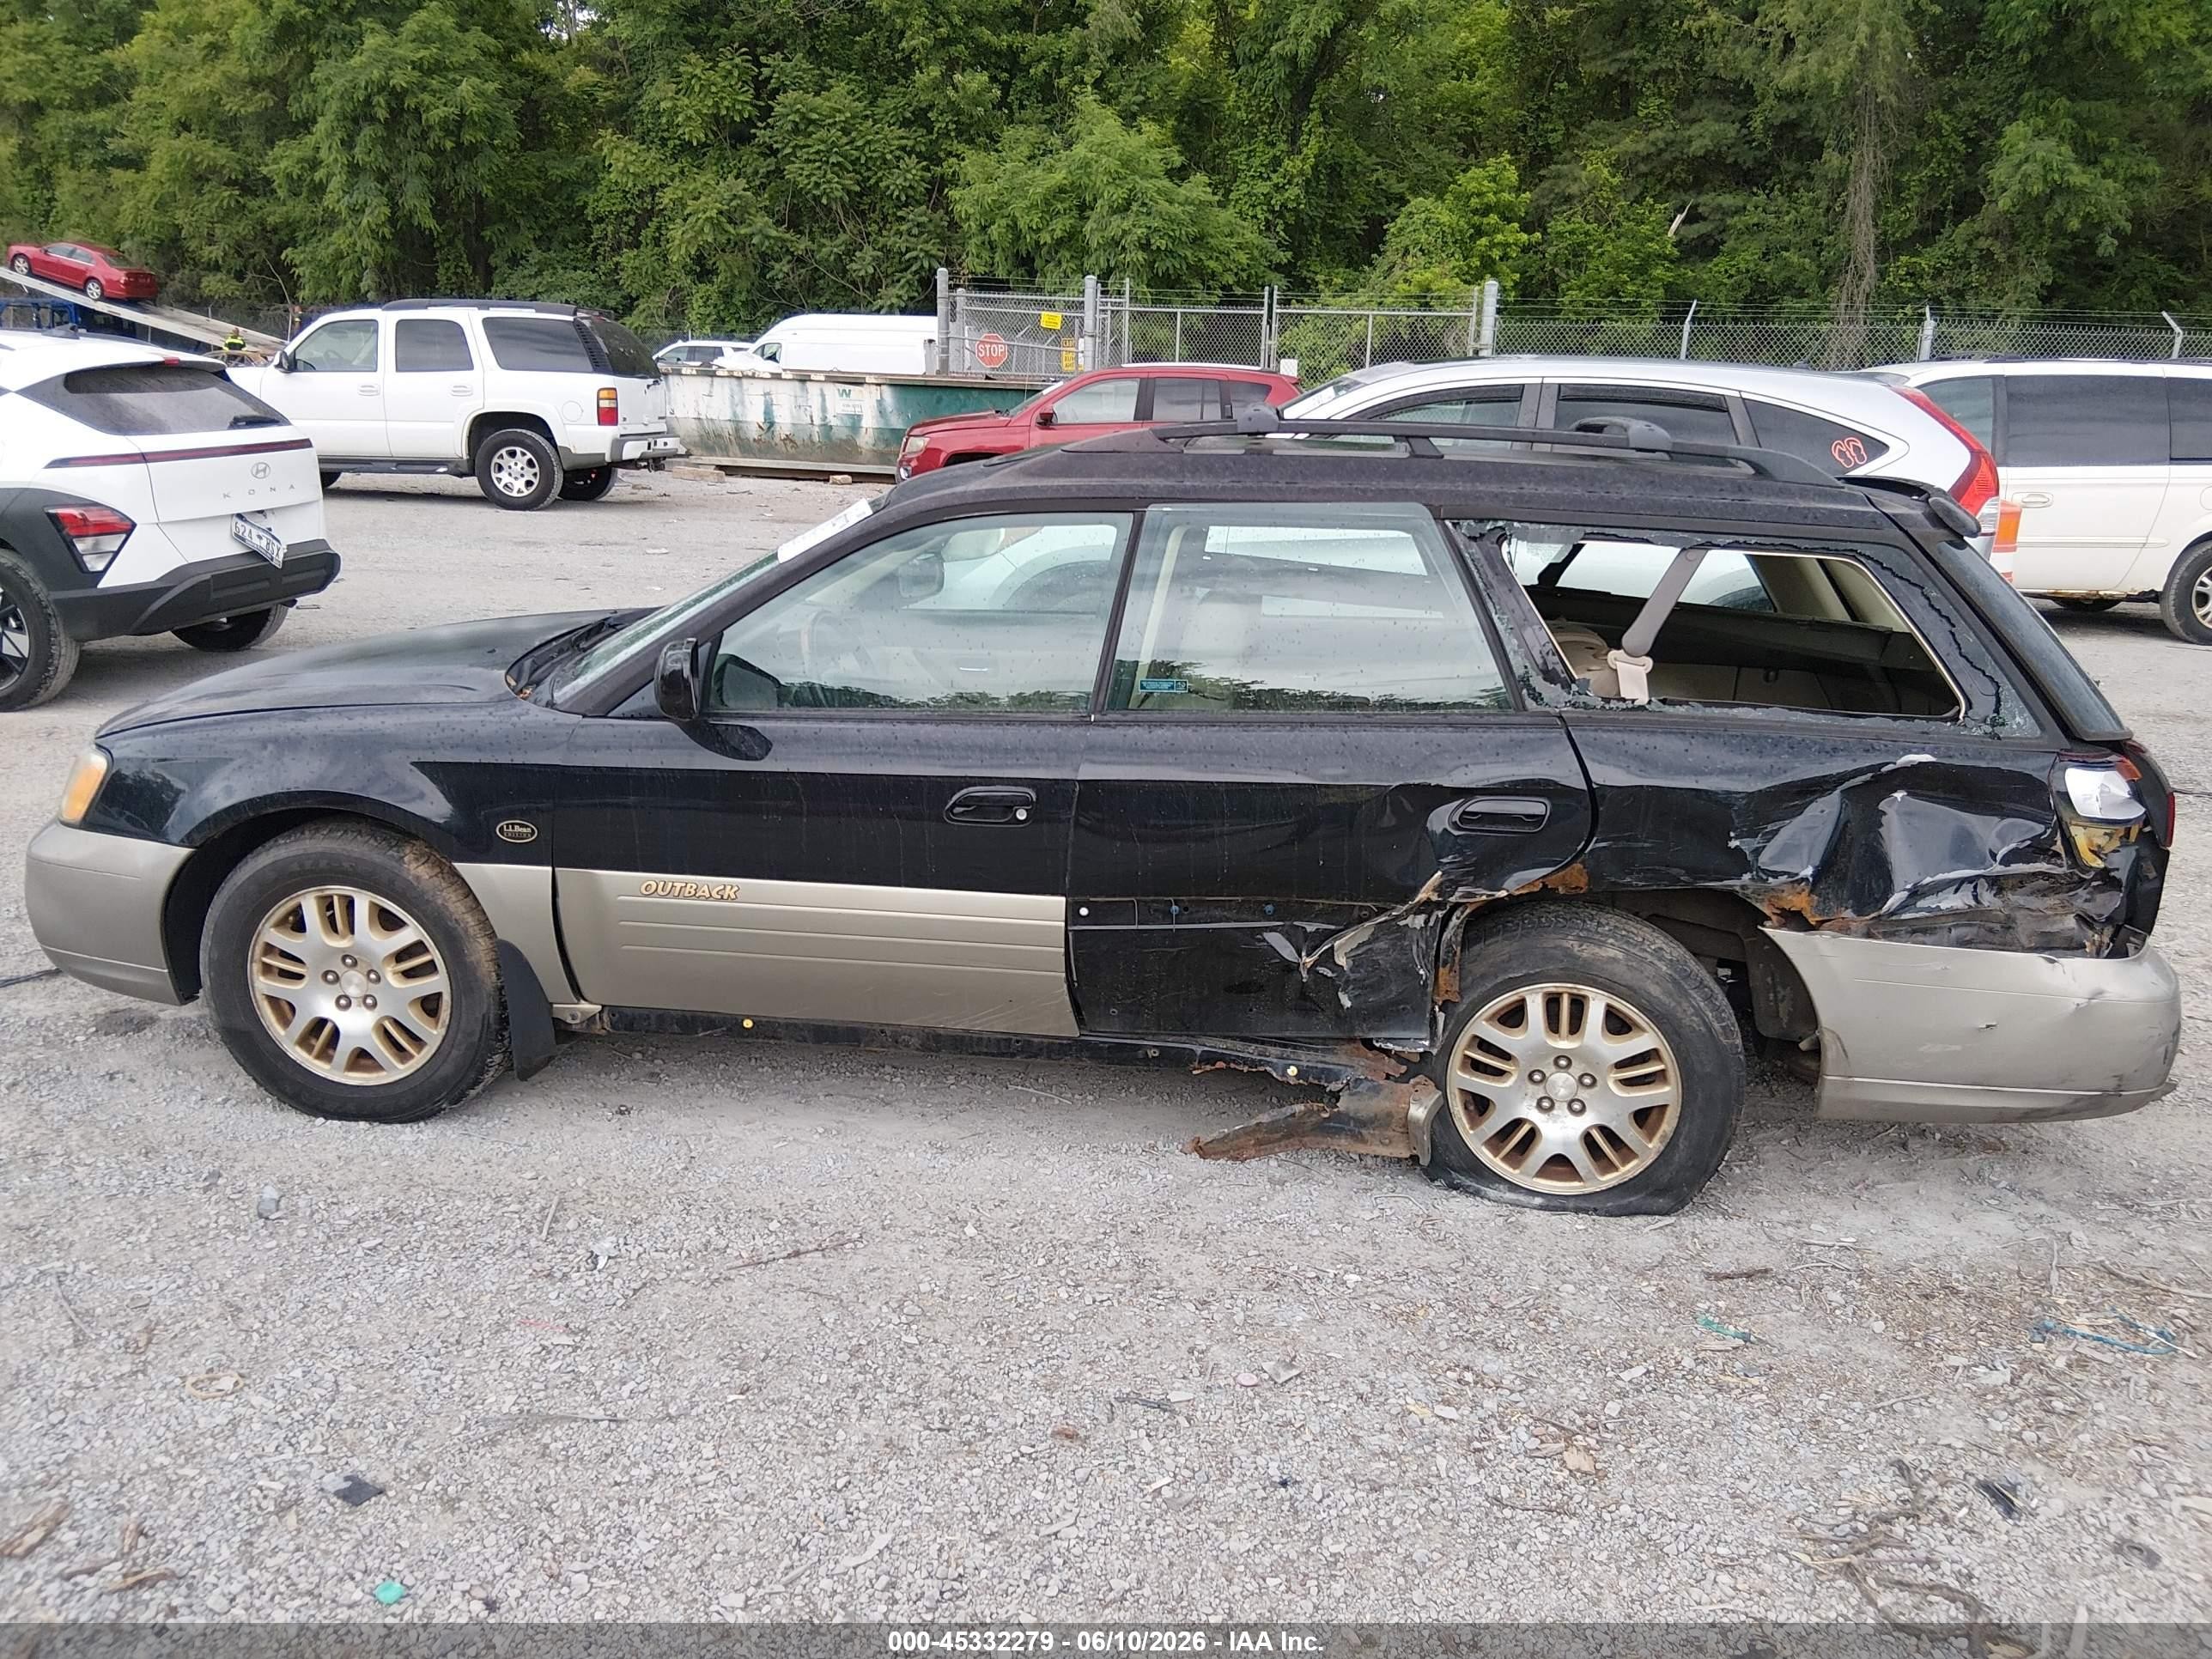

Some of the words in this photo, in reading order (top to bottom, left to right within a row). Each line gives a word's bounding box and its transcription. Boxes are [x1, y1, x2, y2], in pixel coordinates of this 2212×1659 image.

[978, 343, 1006, 358] STOP
[222, 483, 296, 500] KONA
[640, 880, 740, 901] OUTBACK
